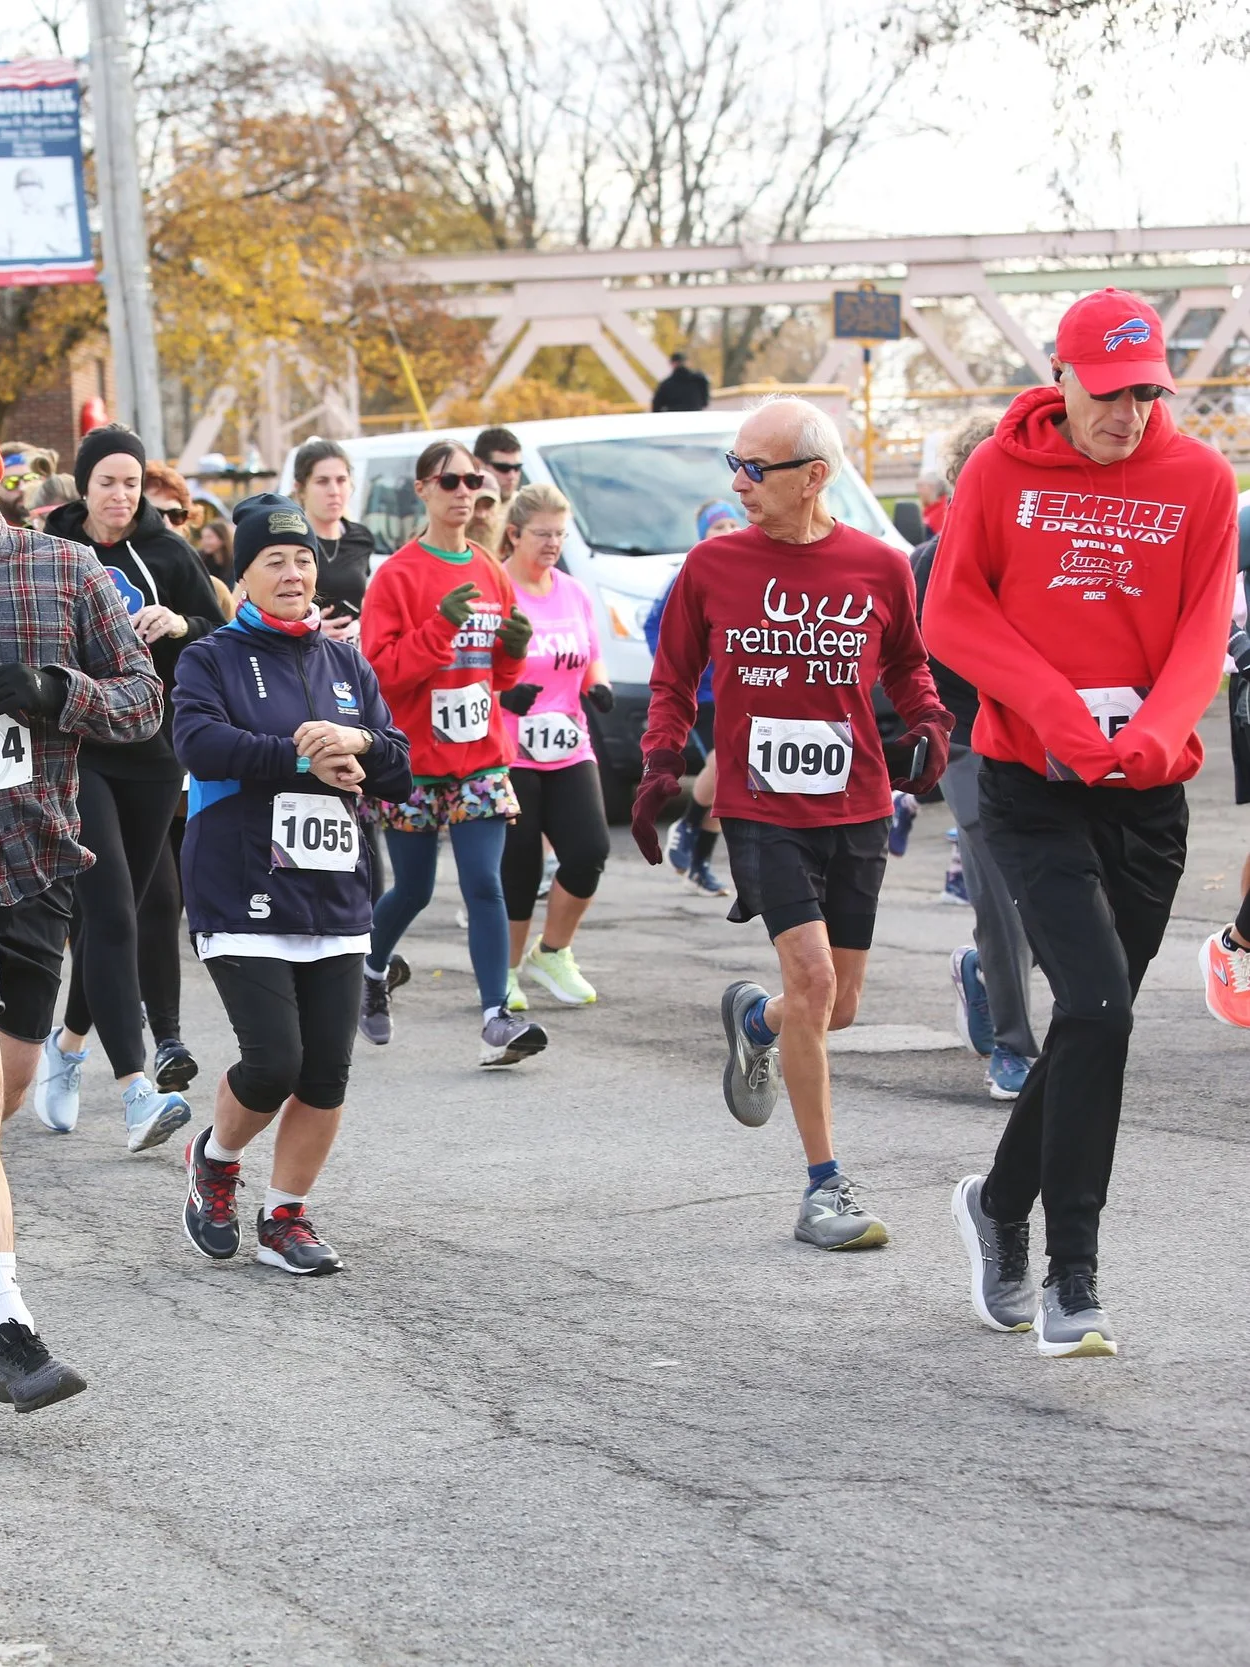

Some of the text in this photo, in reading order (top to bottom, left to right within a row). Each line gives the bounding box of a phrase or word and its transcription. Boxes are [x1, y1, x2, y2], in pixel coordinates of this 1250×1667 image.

[1034, 490, 1186, 532] EMPIRE
[1042, 519, 1175, 544] DRAGWAY
[1083, 591, 1107, 600] 2025
[725, 619, 867, 657] reindeer
[554, 651, 587, 671] run
[738, 666, 777, 677] FLEET
[805, 660, 860, 686] run
[742, 675, 774, 686] FEET
[438, 698, 489, 730] 1138
[524, 727, 579, 749] 1143
[757, 740, 845, 776] 1090
[281, 815, 354, 853] 1055
